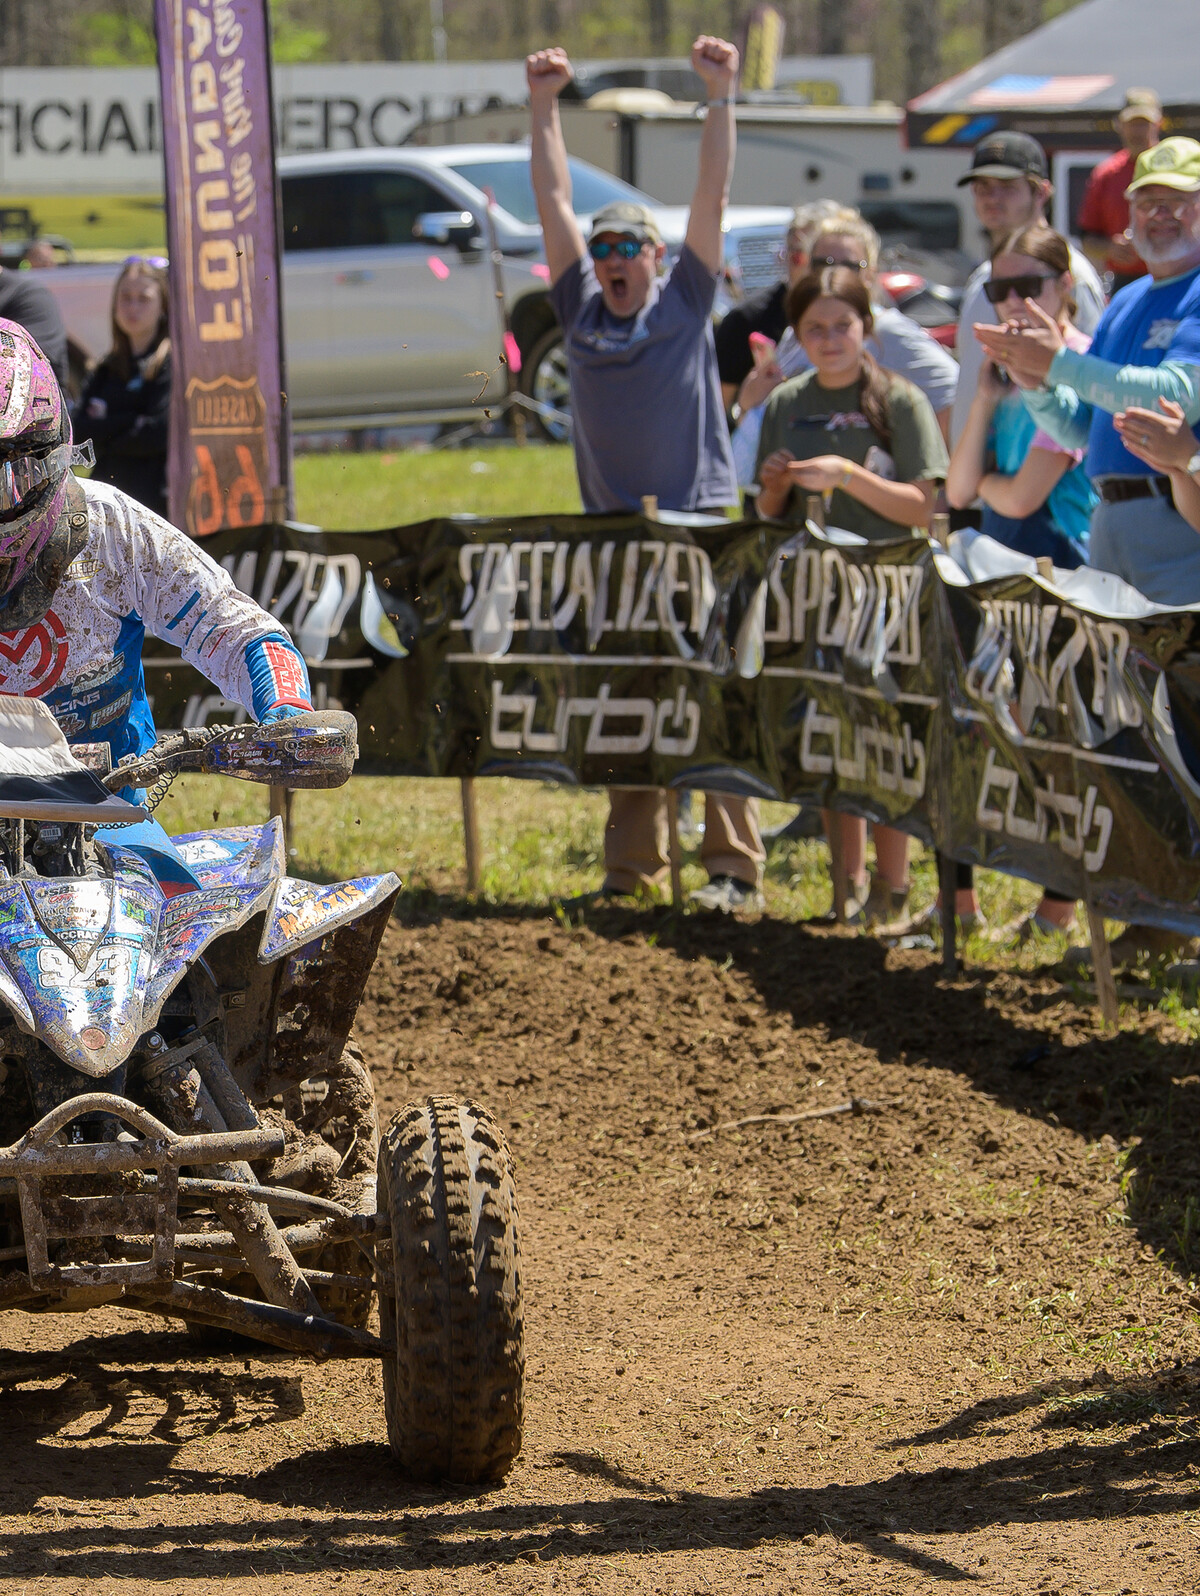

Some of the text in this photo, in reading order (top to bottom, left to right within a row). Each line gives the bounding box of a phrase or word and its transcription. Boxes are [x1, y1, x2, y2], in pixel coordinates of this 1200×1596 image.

[451, 541, 716, 634] SPECIALIZED
[72, 651, 125, 687] AXIS
[490, 680, 700, 756] turbo
[39, 947, 130, 988] 923
